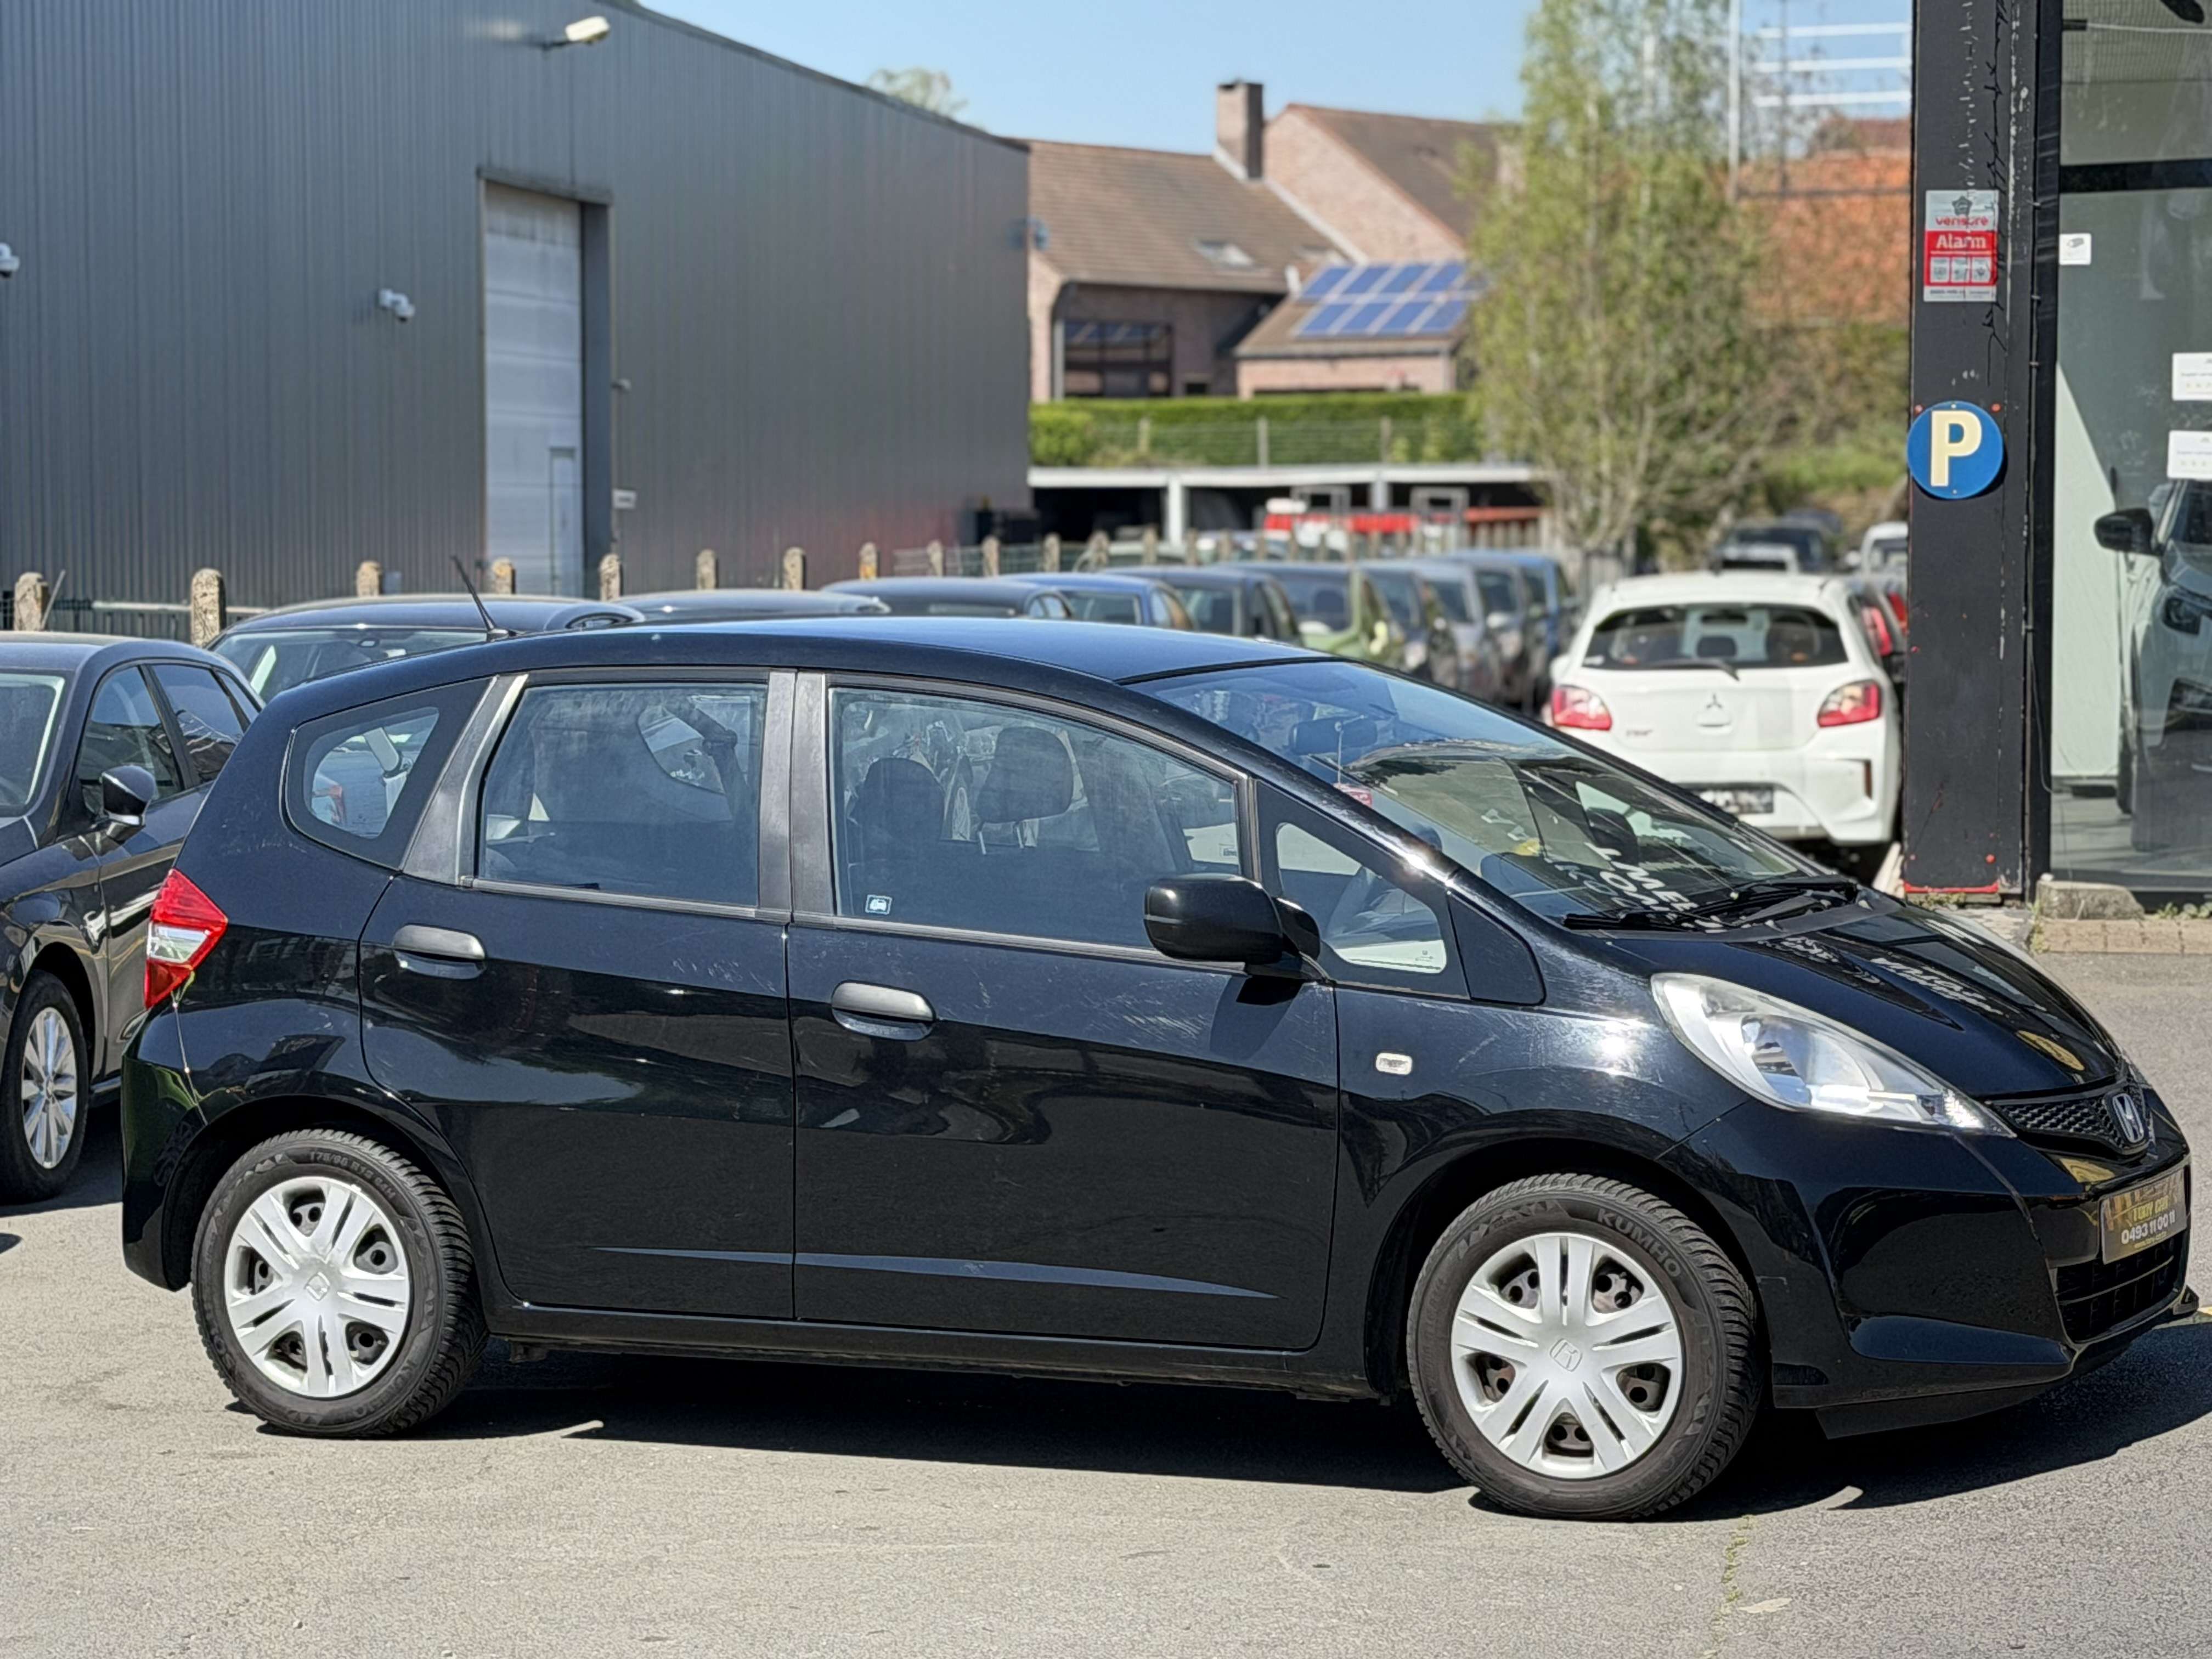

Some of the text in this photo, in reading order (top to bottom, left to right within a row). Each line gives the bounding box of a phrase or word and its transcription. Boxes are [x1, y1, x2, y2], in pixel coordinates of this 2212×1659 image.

[1936, 233, 1987, 249] Alarm
[1931, 410, 1982, 487] P
[1598, 1208, 1681, 1277] KUMHO
[2121, 1222, 2148, 1244] 0493
